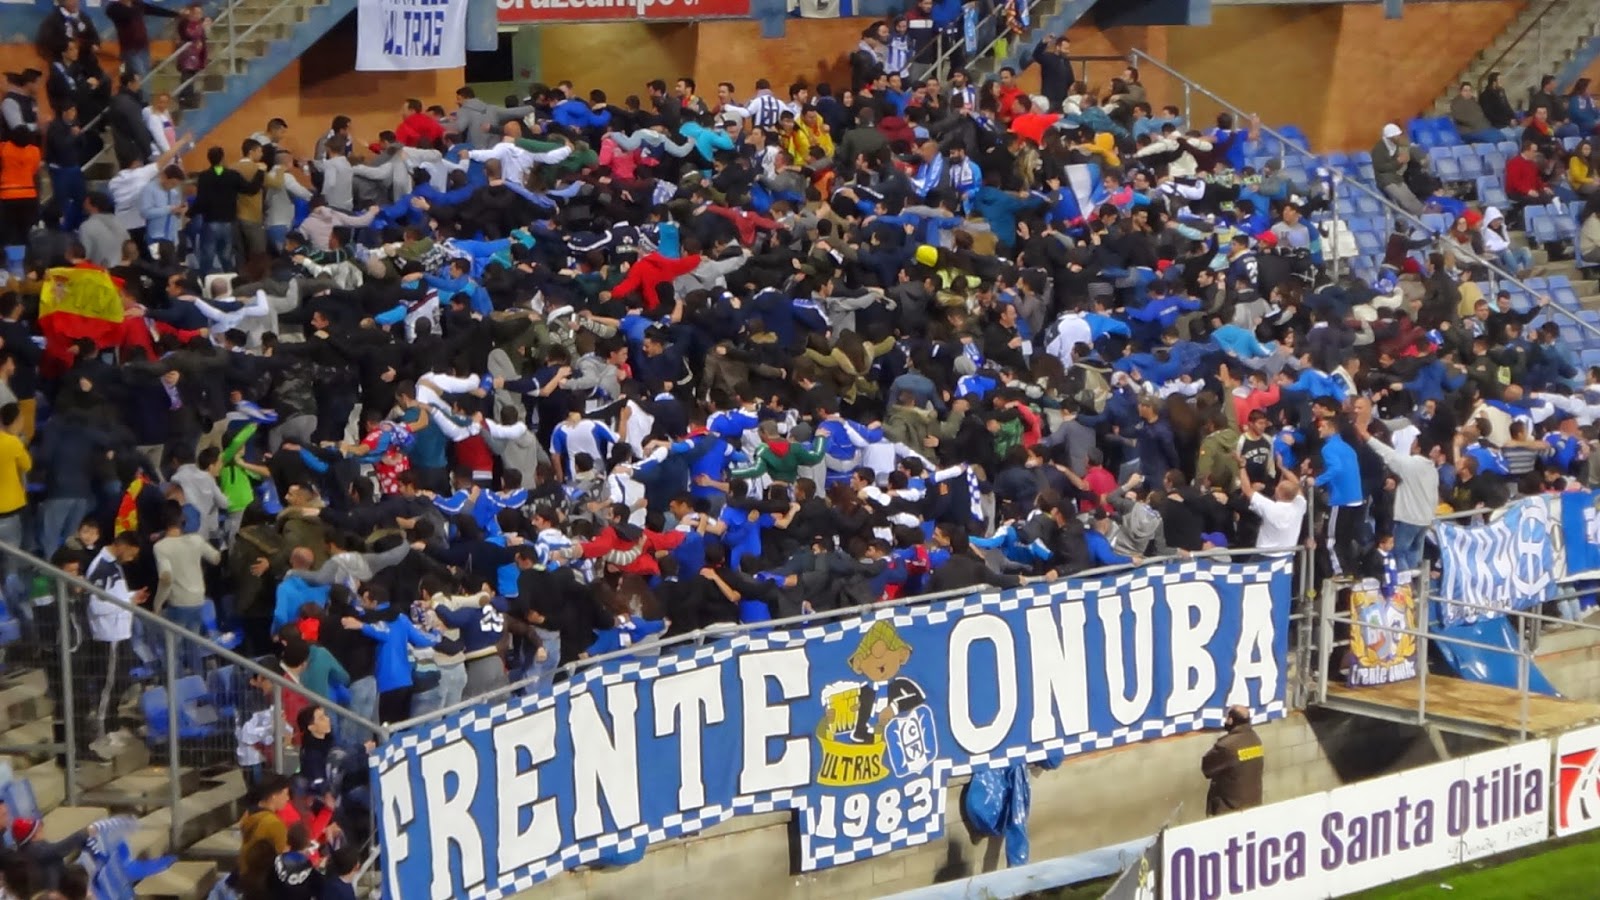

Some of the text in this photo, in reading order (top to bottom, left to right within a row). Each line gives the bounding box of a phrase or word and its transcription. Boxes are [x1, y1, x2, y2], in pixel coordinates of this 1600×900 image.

[379, 581, 1278, 900] FRENTE ONUBA
[820, 751, 882, 782] ULTRAS
[815, 777, 933, 839] 1983
[1170, 763, 1545, 900] Optica Santa Otilia
